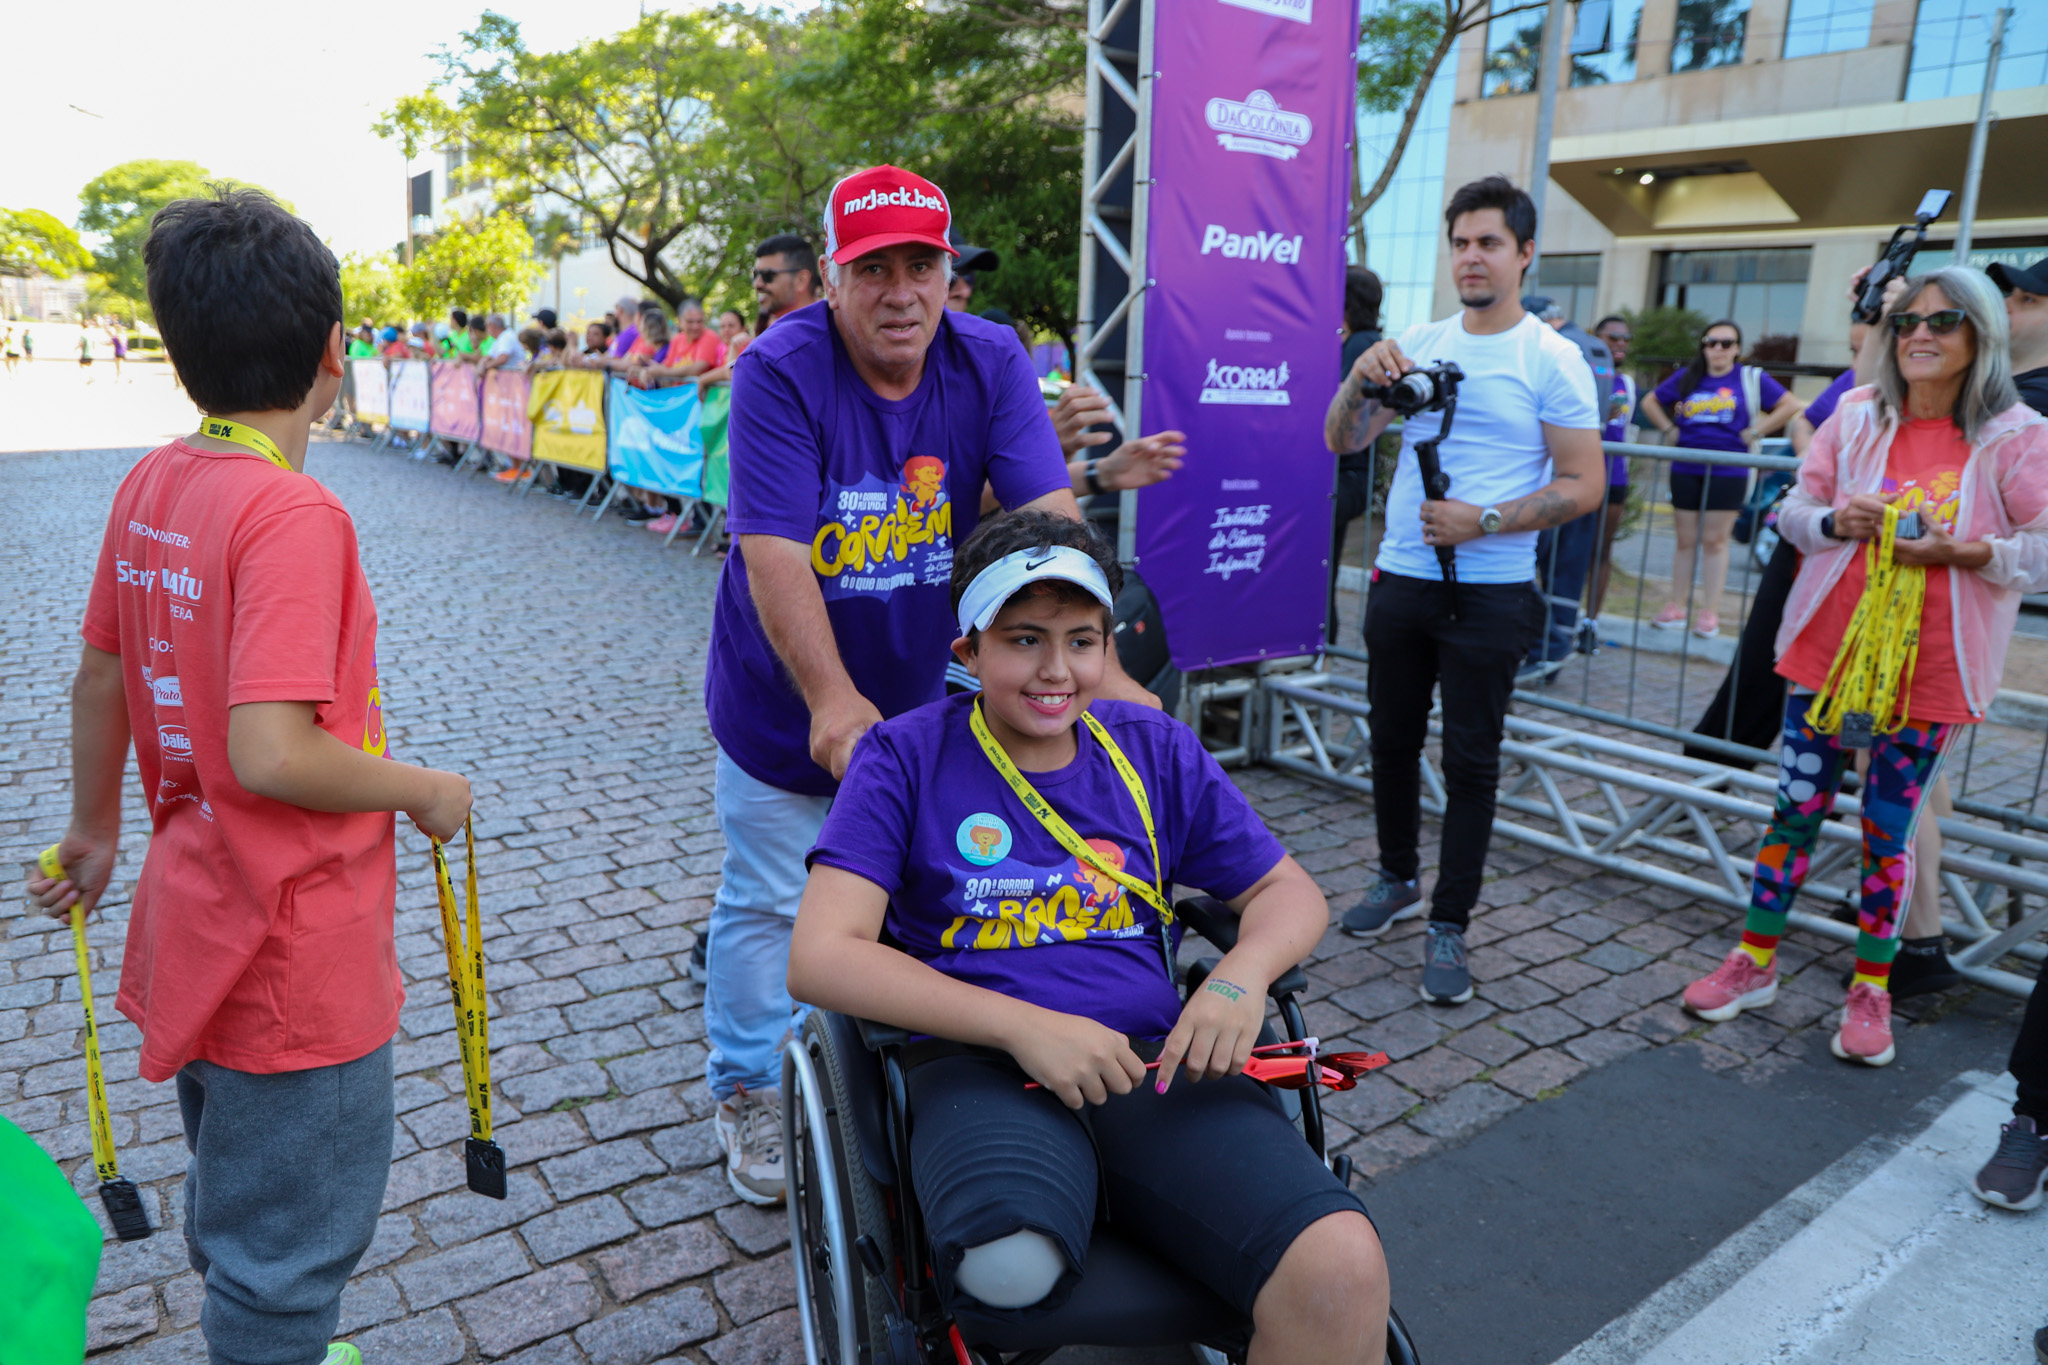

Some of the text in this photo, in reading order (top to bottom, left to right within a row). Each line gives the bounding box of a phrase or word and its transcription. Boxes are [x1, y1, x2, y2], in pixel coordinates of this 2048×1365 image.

[1201, 224, 1303, 264] PanVel
[867, 501, 887, 511] VIDA
[855, 577, 874, 591] que
[155, 684, 180, 701] Prato
[160, 732, 192, 750] Dália
[997, 879, 1034, 891] CORRIDA
[1004, 889, 1032, 897] VIDA
[1207, 983, 1240, 1002] VIDA
